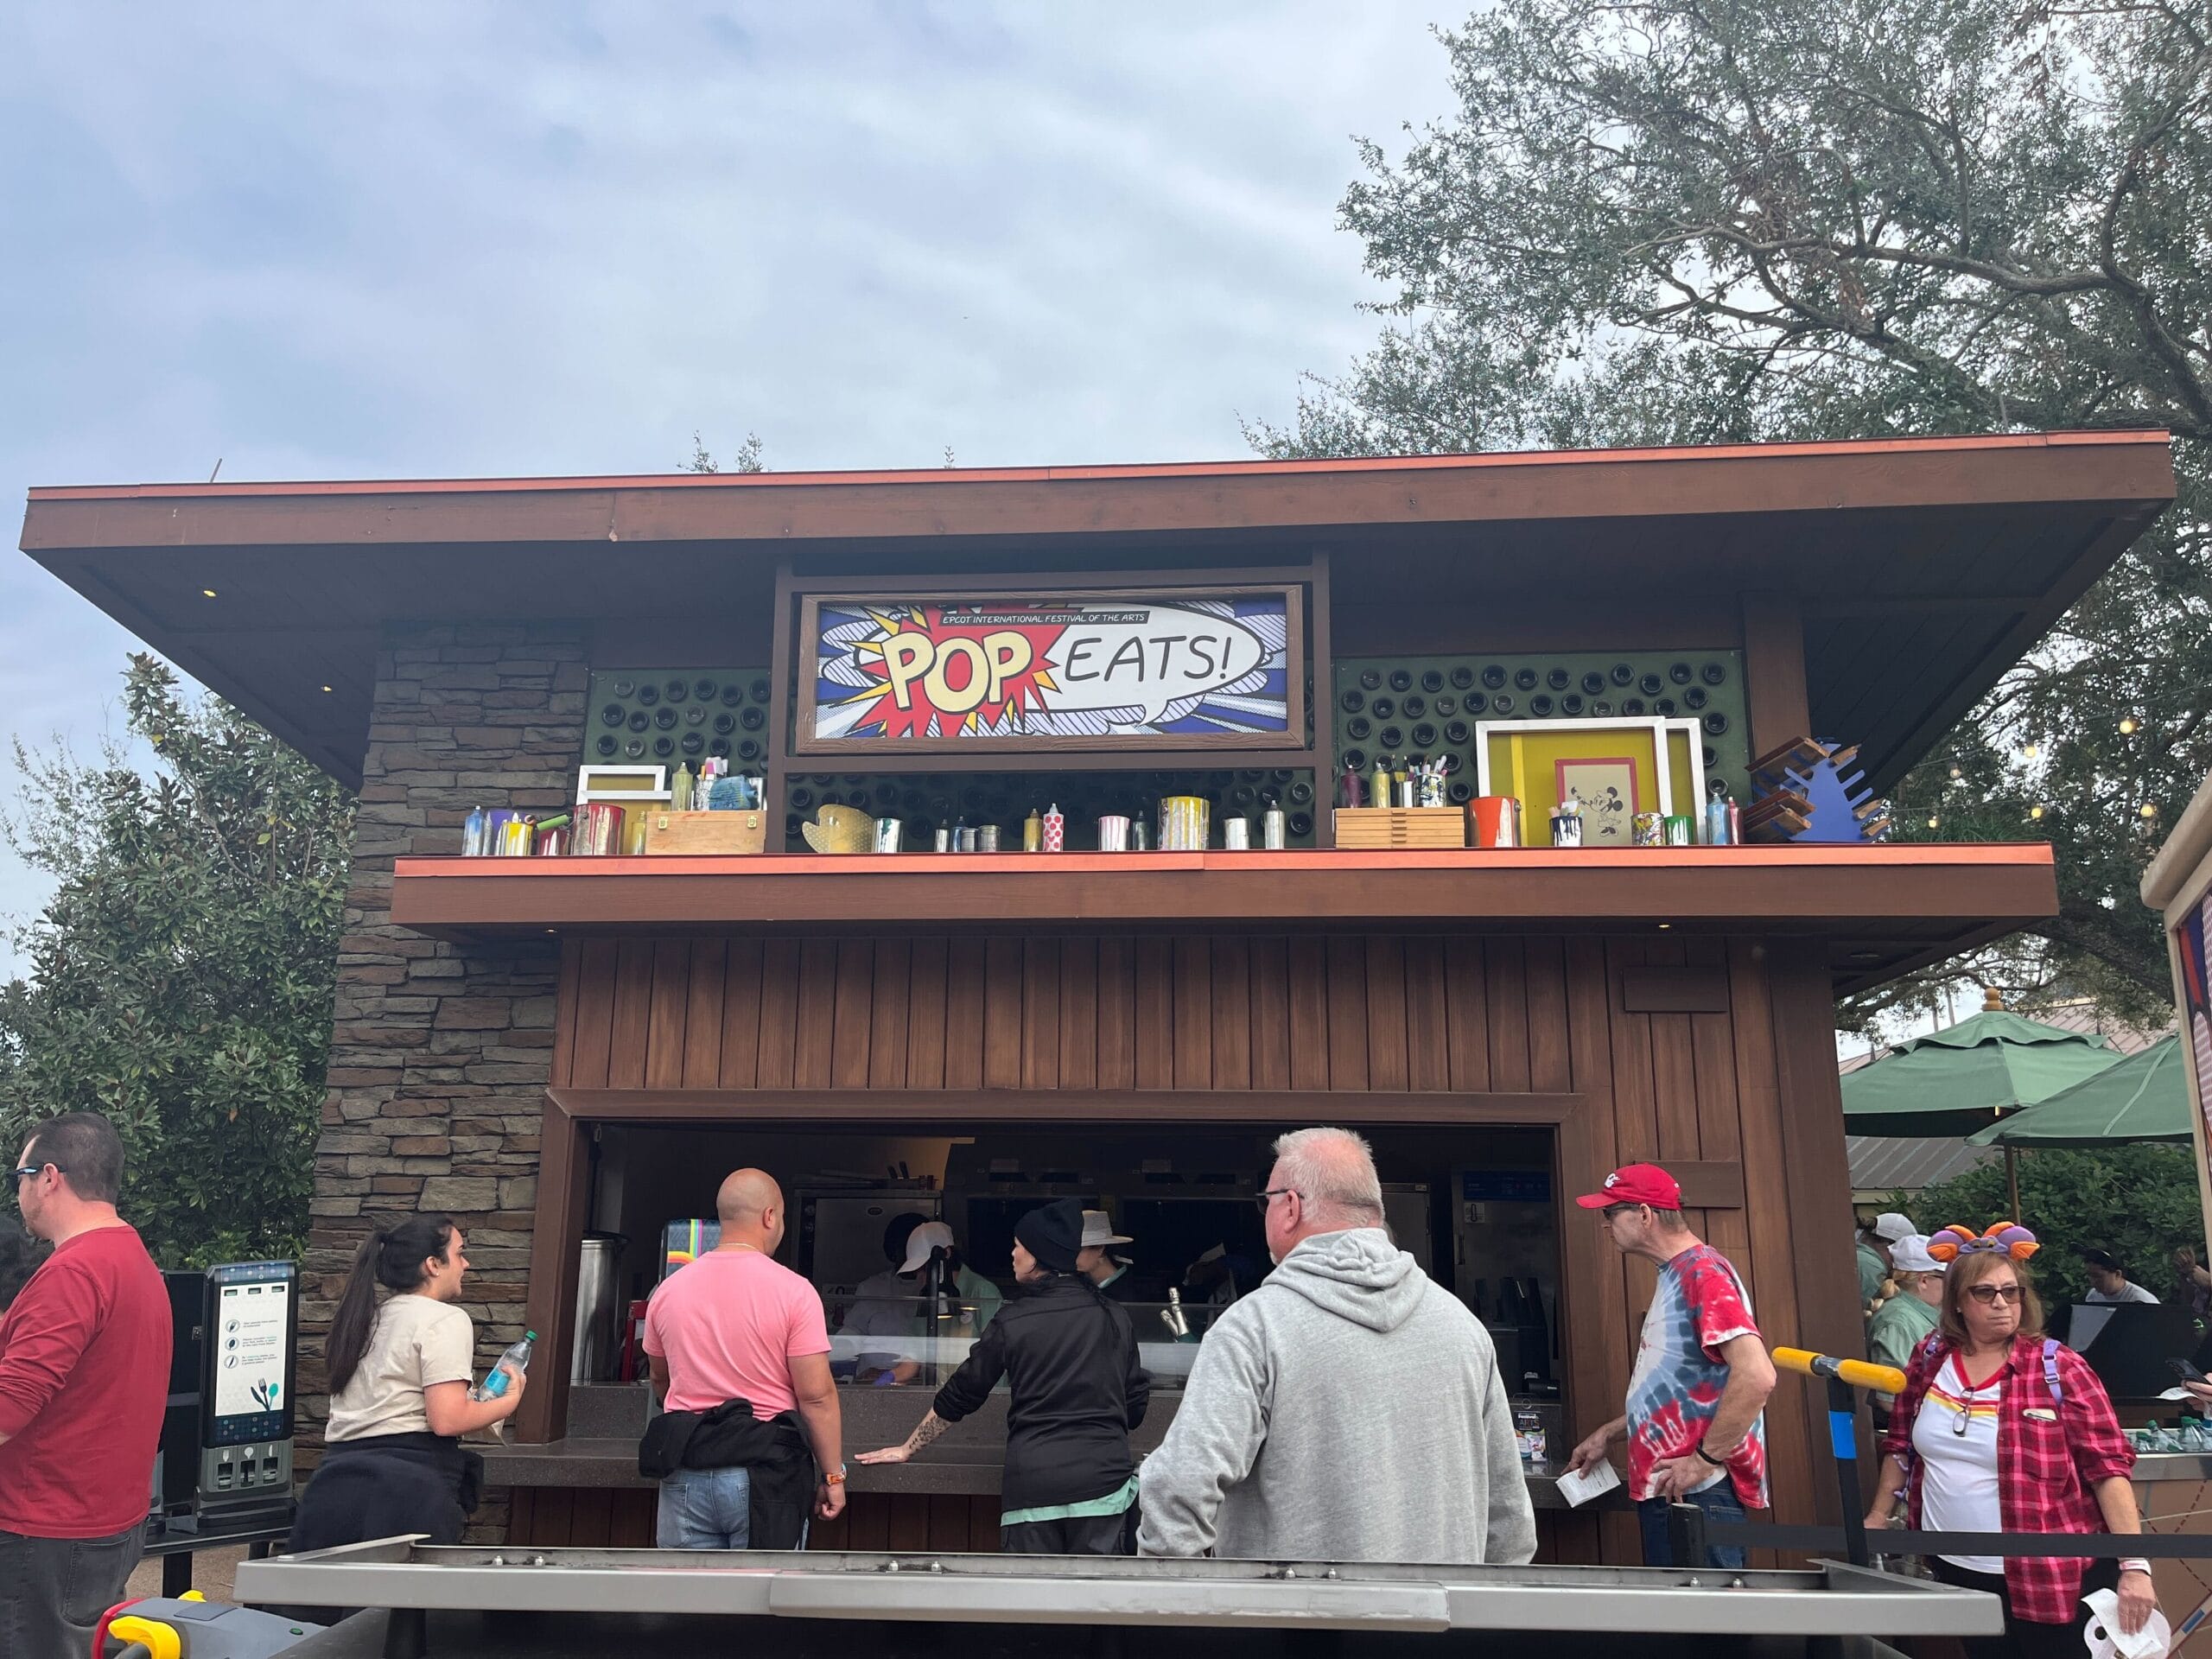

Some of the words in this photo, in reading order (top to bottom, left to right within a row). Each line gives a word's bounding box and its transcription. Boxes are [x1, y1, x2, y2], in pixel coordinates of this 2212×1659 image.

[942, 614, 971, 625] EPCOT
[973, 613, 1043, 624] INTERNATIONAL
[1046, 613, 1086, 623] FESTIVAL
[1089, 613, 1101, 622] OF
[1103, 613, 1120, 622] THE
[1121, 613, 1145, 622] ARTS
[882, 631, 1033, 712] POP
[1065, 635, 1232, 682] EATS!
